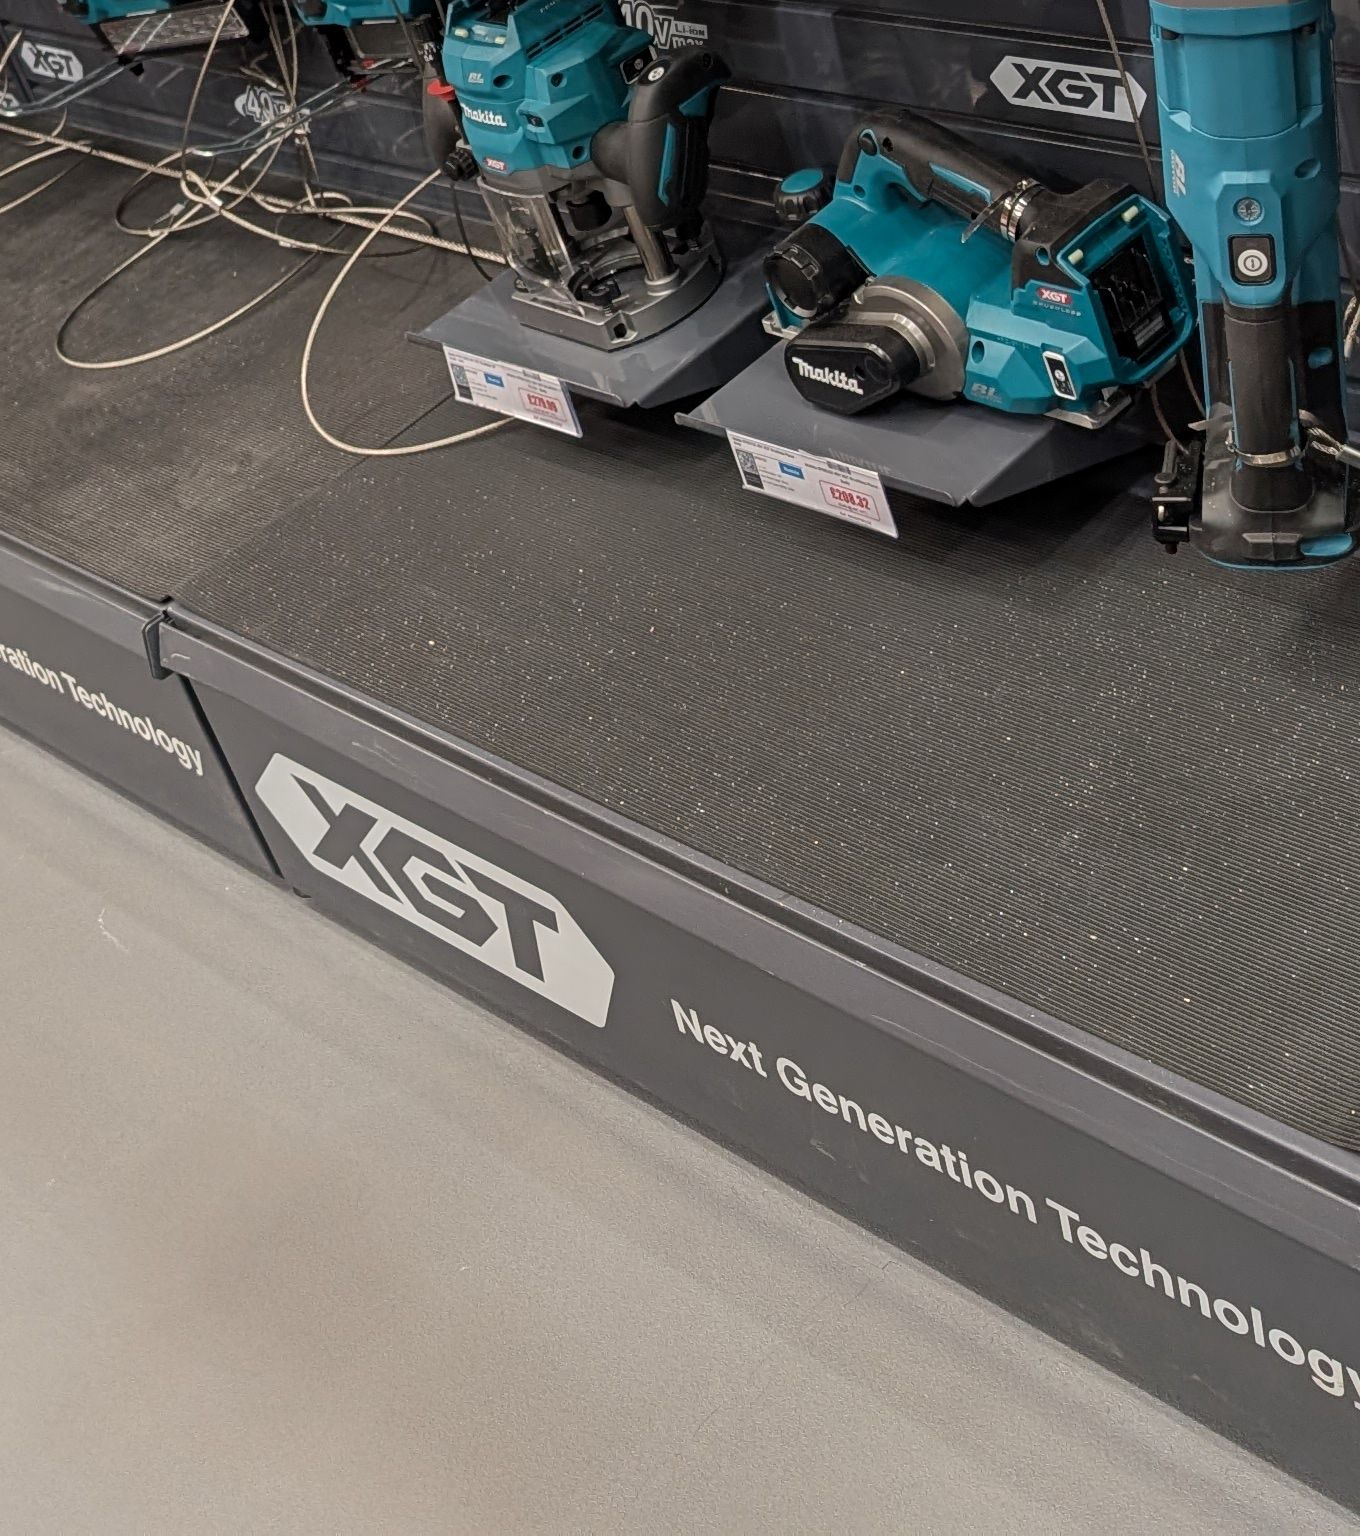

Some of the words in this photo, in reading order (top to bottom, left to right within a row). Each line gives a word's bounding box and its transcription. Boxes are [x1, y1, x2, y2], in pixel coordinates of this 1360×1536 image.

[1012, 62, 1128, 115] XGT
[1041, 289, 1069, 304] XGT
[829, 485, 872, 511] £208.32
[59, 671, 204, 777] Technology
[289, 772, 561, 984] XGT
[670, 998, 768, 1080] Next
[776, 1057, 1038, 1224] Generation
